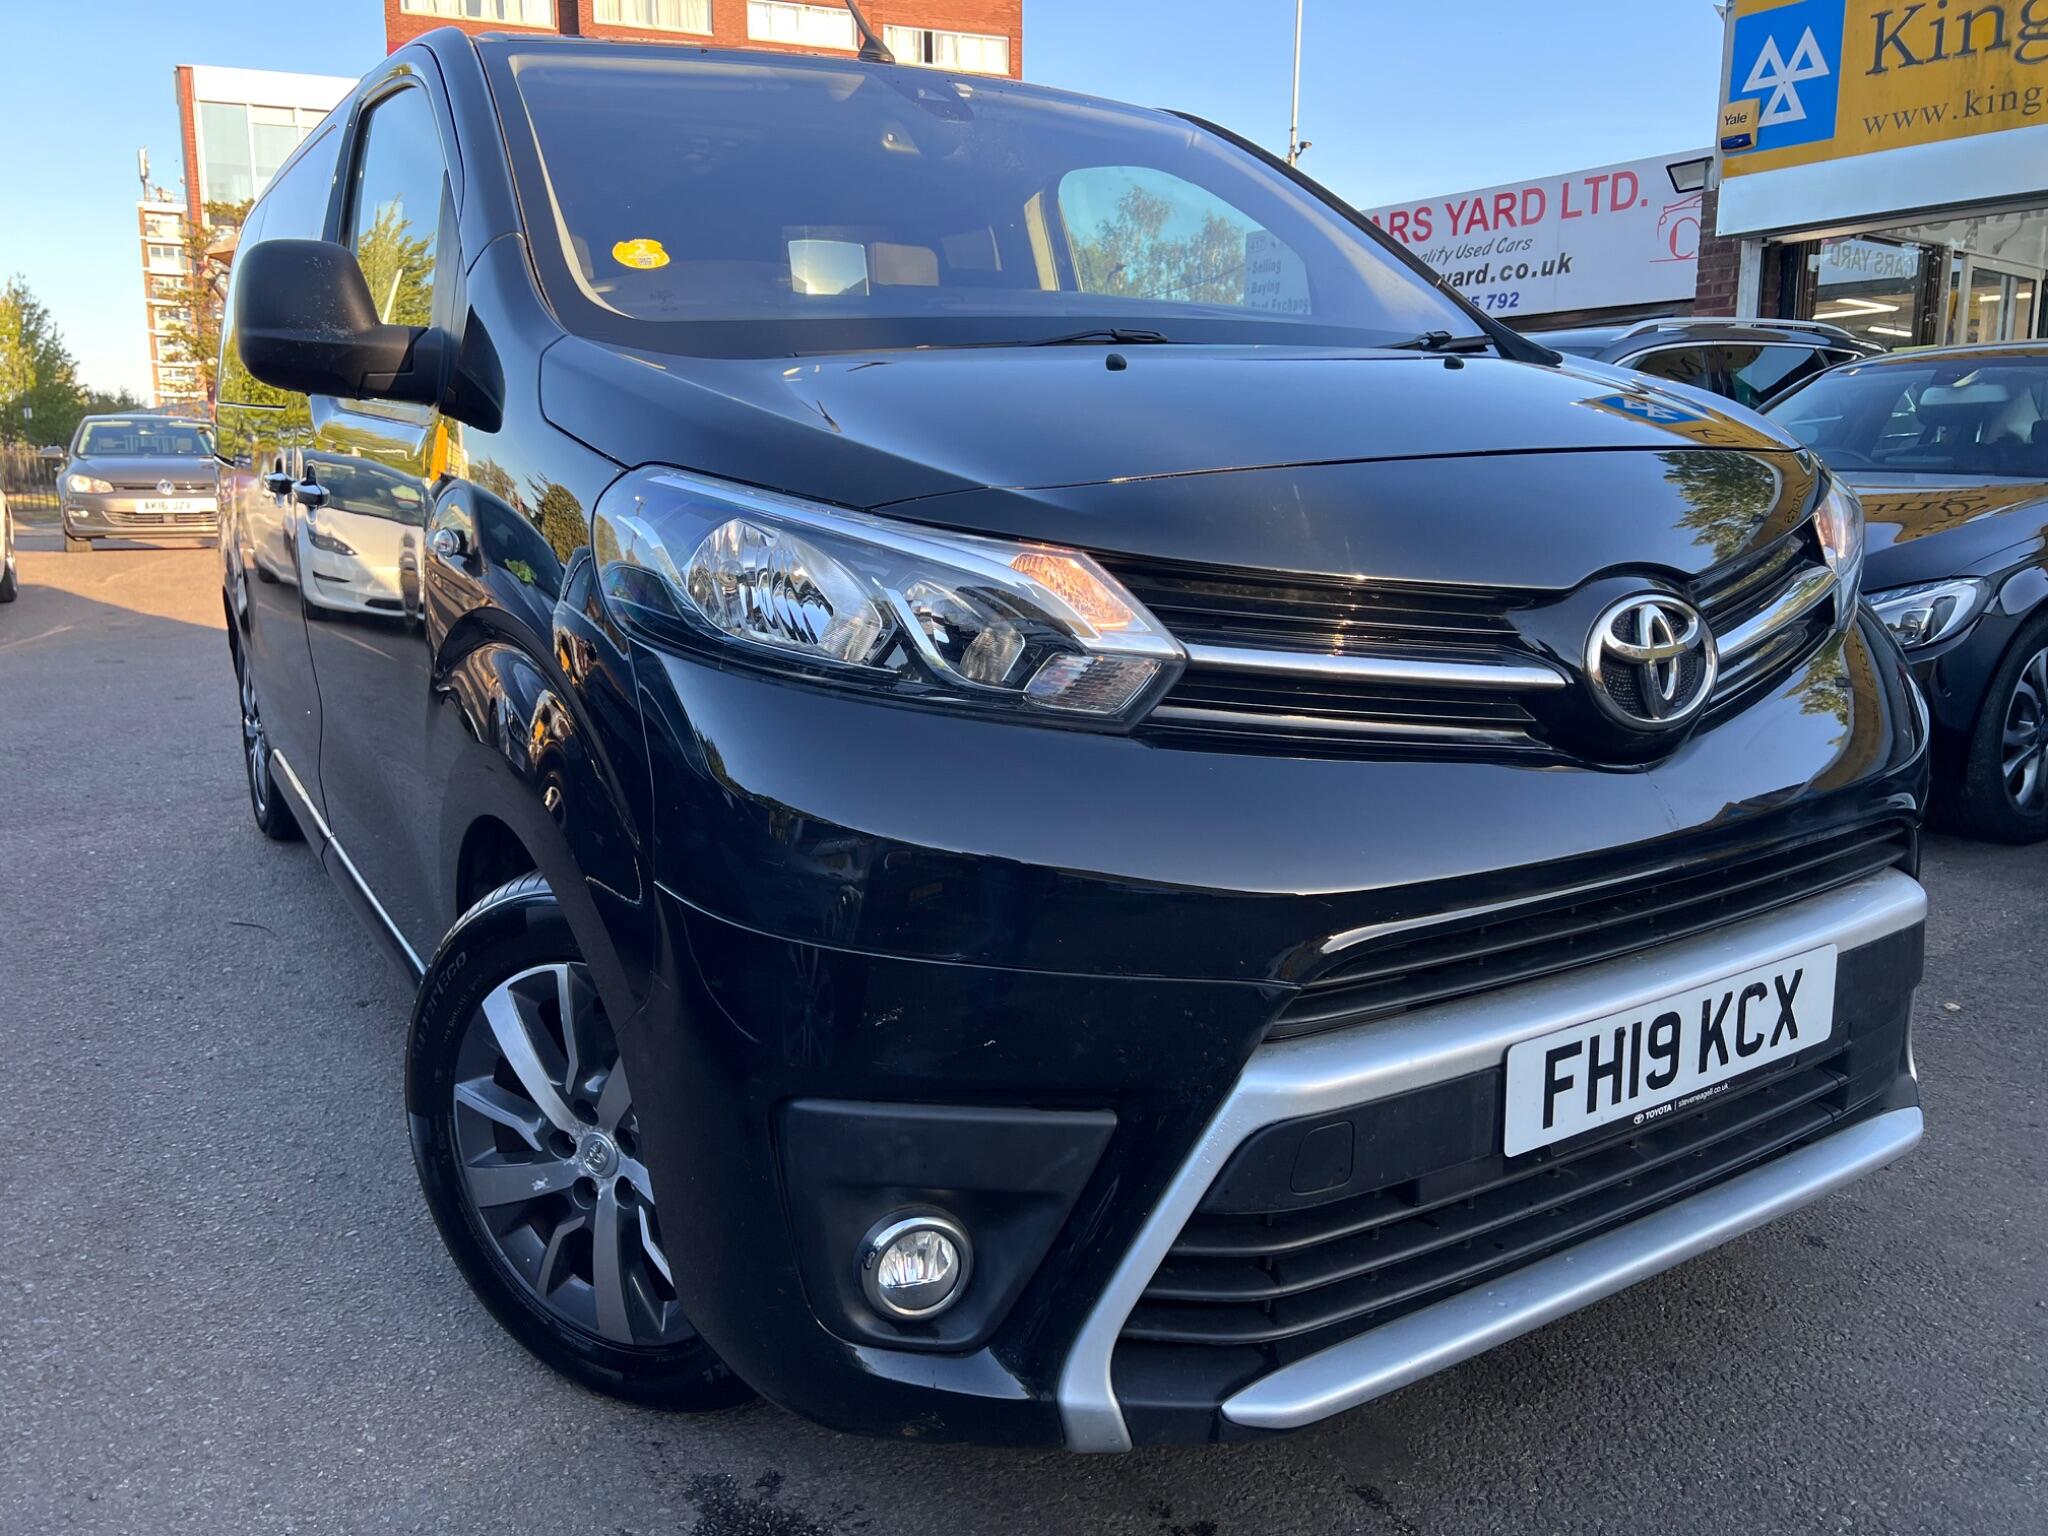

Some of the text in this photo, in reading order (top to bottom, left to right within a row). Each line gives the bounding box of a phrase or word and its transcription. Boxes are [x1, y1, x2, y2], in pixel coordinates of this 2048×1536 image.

[1724, 112, 1748, 126] Yale
[1863, 84, 2048, 135] www.king
[1444, 187, 1547, 237] YARD
[1560, 171, 1649, 220] LTD.
[1455, 238, 1496, 260] Used
[1496, 236, 1534, 254] Cars
[1486, 291, 1520, 310] 792
[1543, 968, 1803, 1129] FH19 KCX
[1645, 1104, 1672, 1120] TOYOTA
